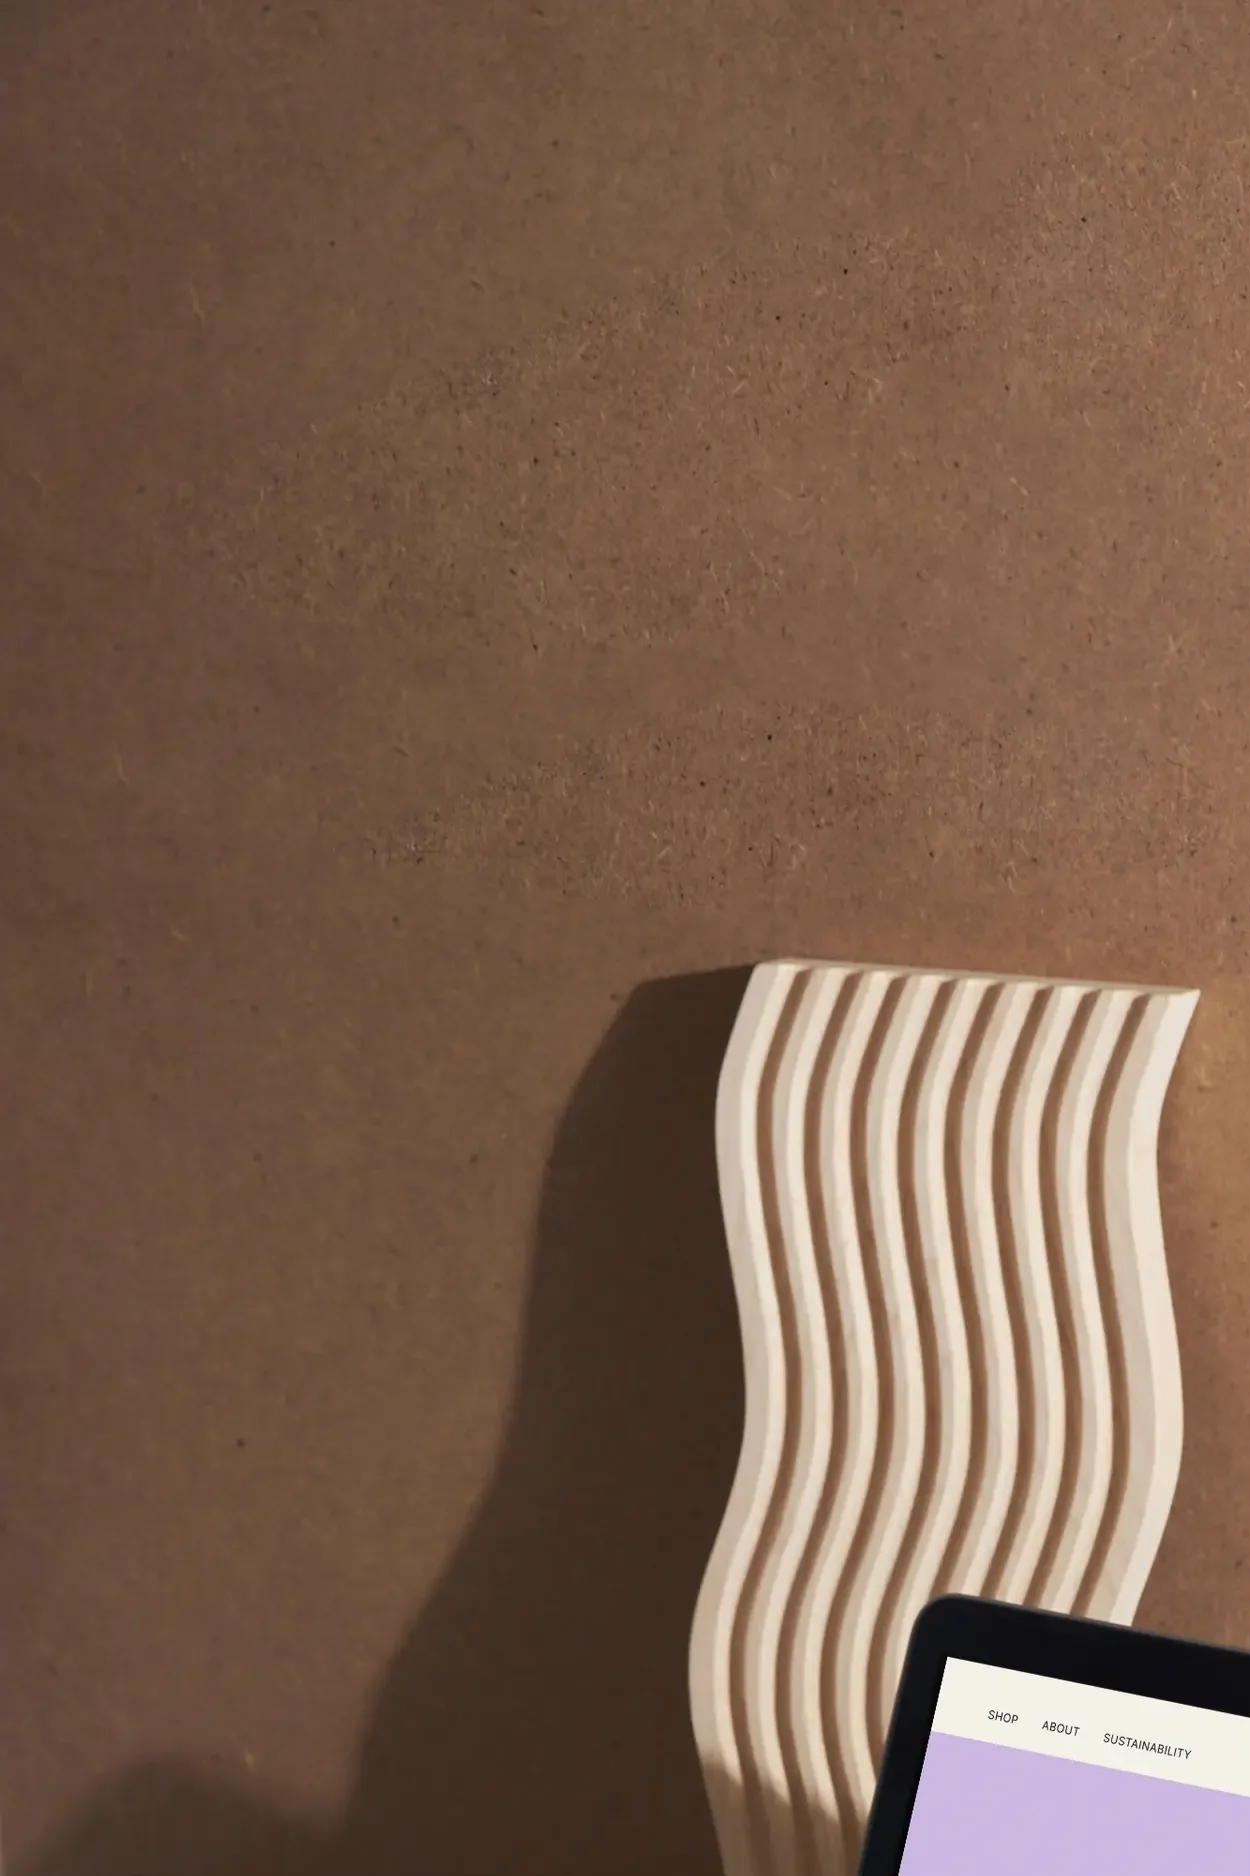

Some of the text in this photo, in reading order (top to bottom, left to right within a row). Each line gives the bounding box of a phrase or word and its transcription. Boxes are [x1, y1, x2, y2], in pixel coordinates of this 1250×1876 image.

[988, 1709, 1019, 1725] SHOP
[1041, 1720, 1080, 1737] ABOUT
[1103, 1732, 1192, 1760] SUSTAINABILITY
